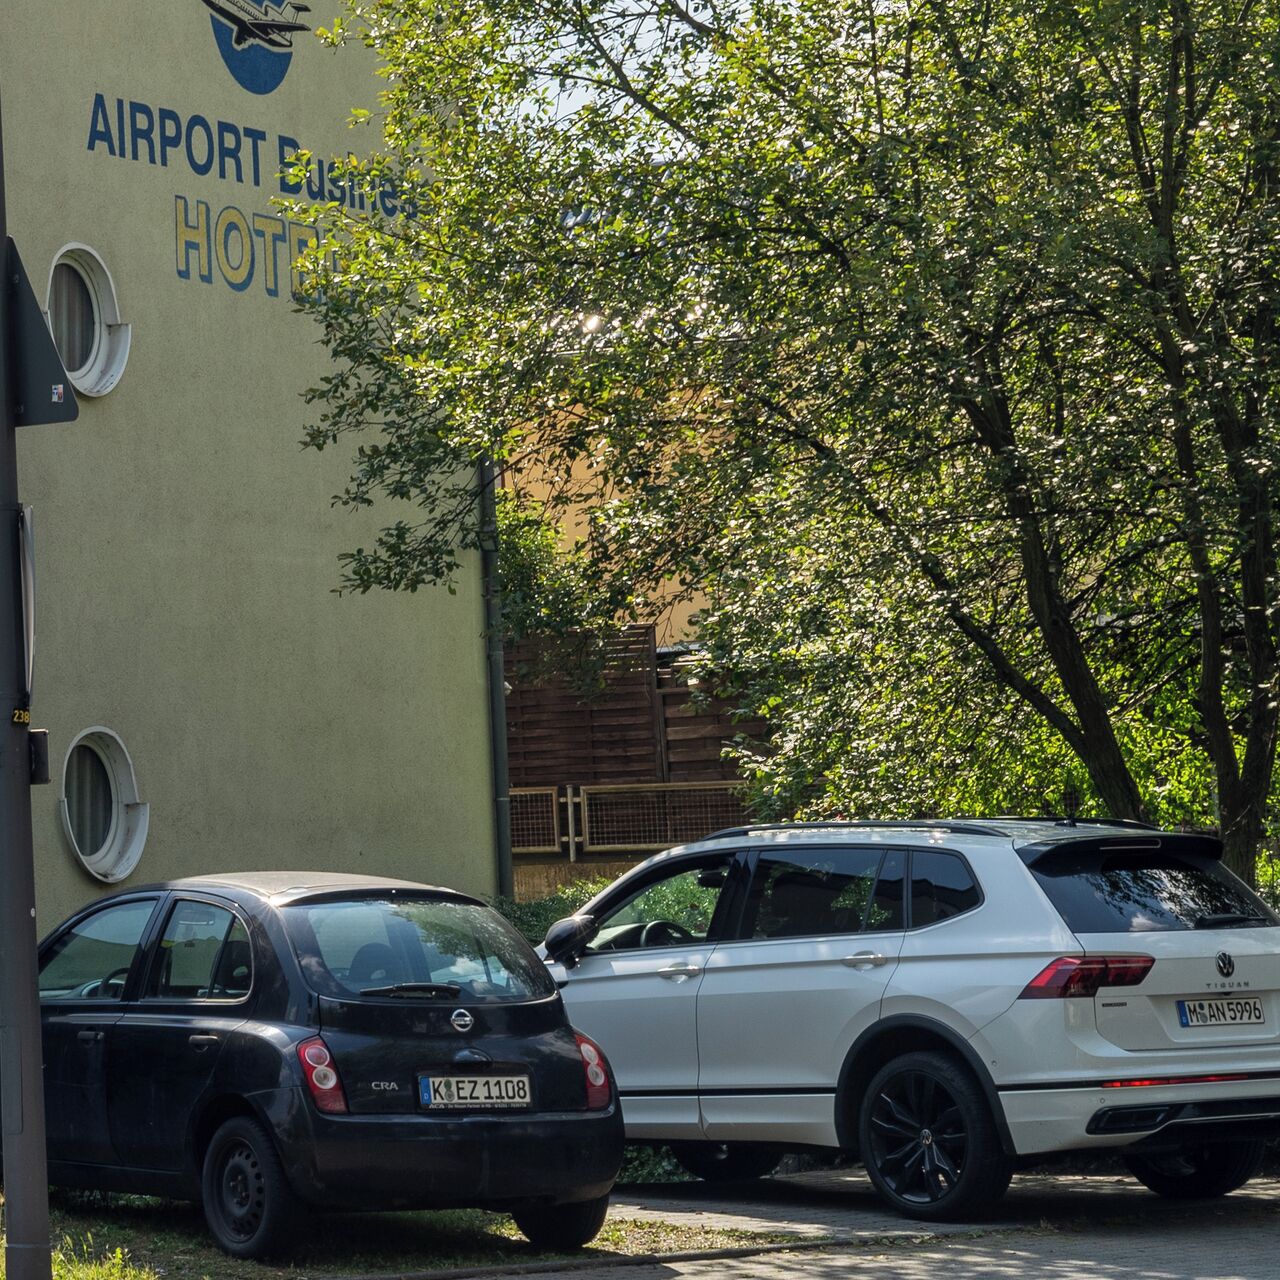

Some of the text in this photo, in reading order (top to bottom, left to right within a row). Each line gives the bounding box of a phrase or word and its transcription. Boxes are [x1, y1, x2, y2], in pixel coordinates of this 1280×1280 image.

[86, 92, 267, 187] AIRPORT
[13, 710, 30, 723] 238
[1206, 981, 1250, 989] TIGUAN
[1188, 1000, 1262, 1023] M AN 5996
[371, 1081, 399, 1090] CRA
[432, 1080, 445, 1100] K
[456, 1080, 481, 1100] EZ
[483, 1079, 527, 1100] 1108
